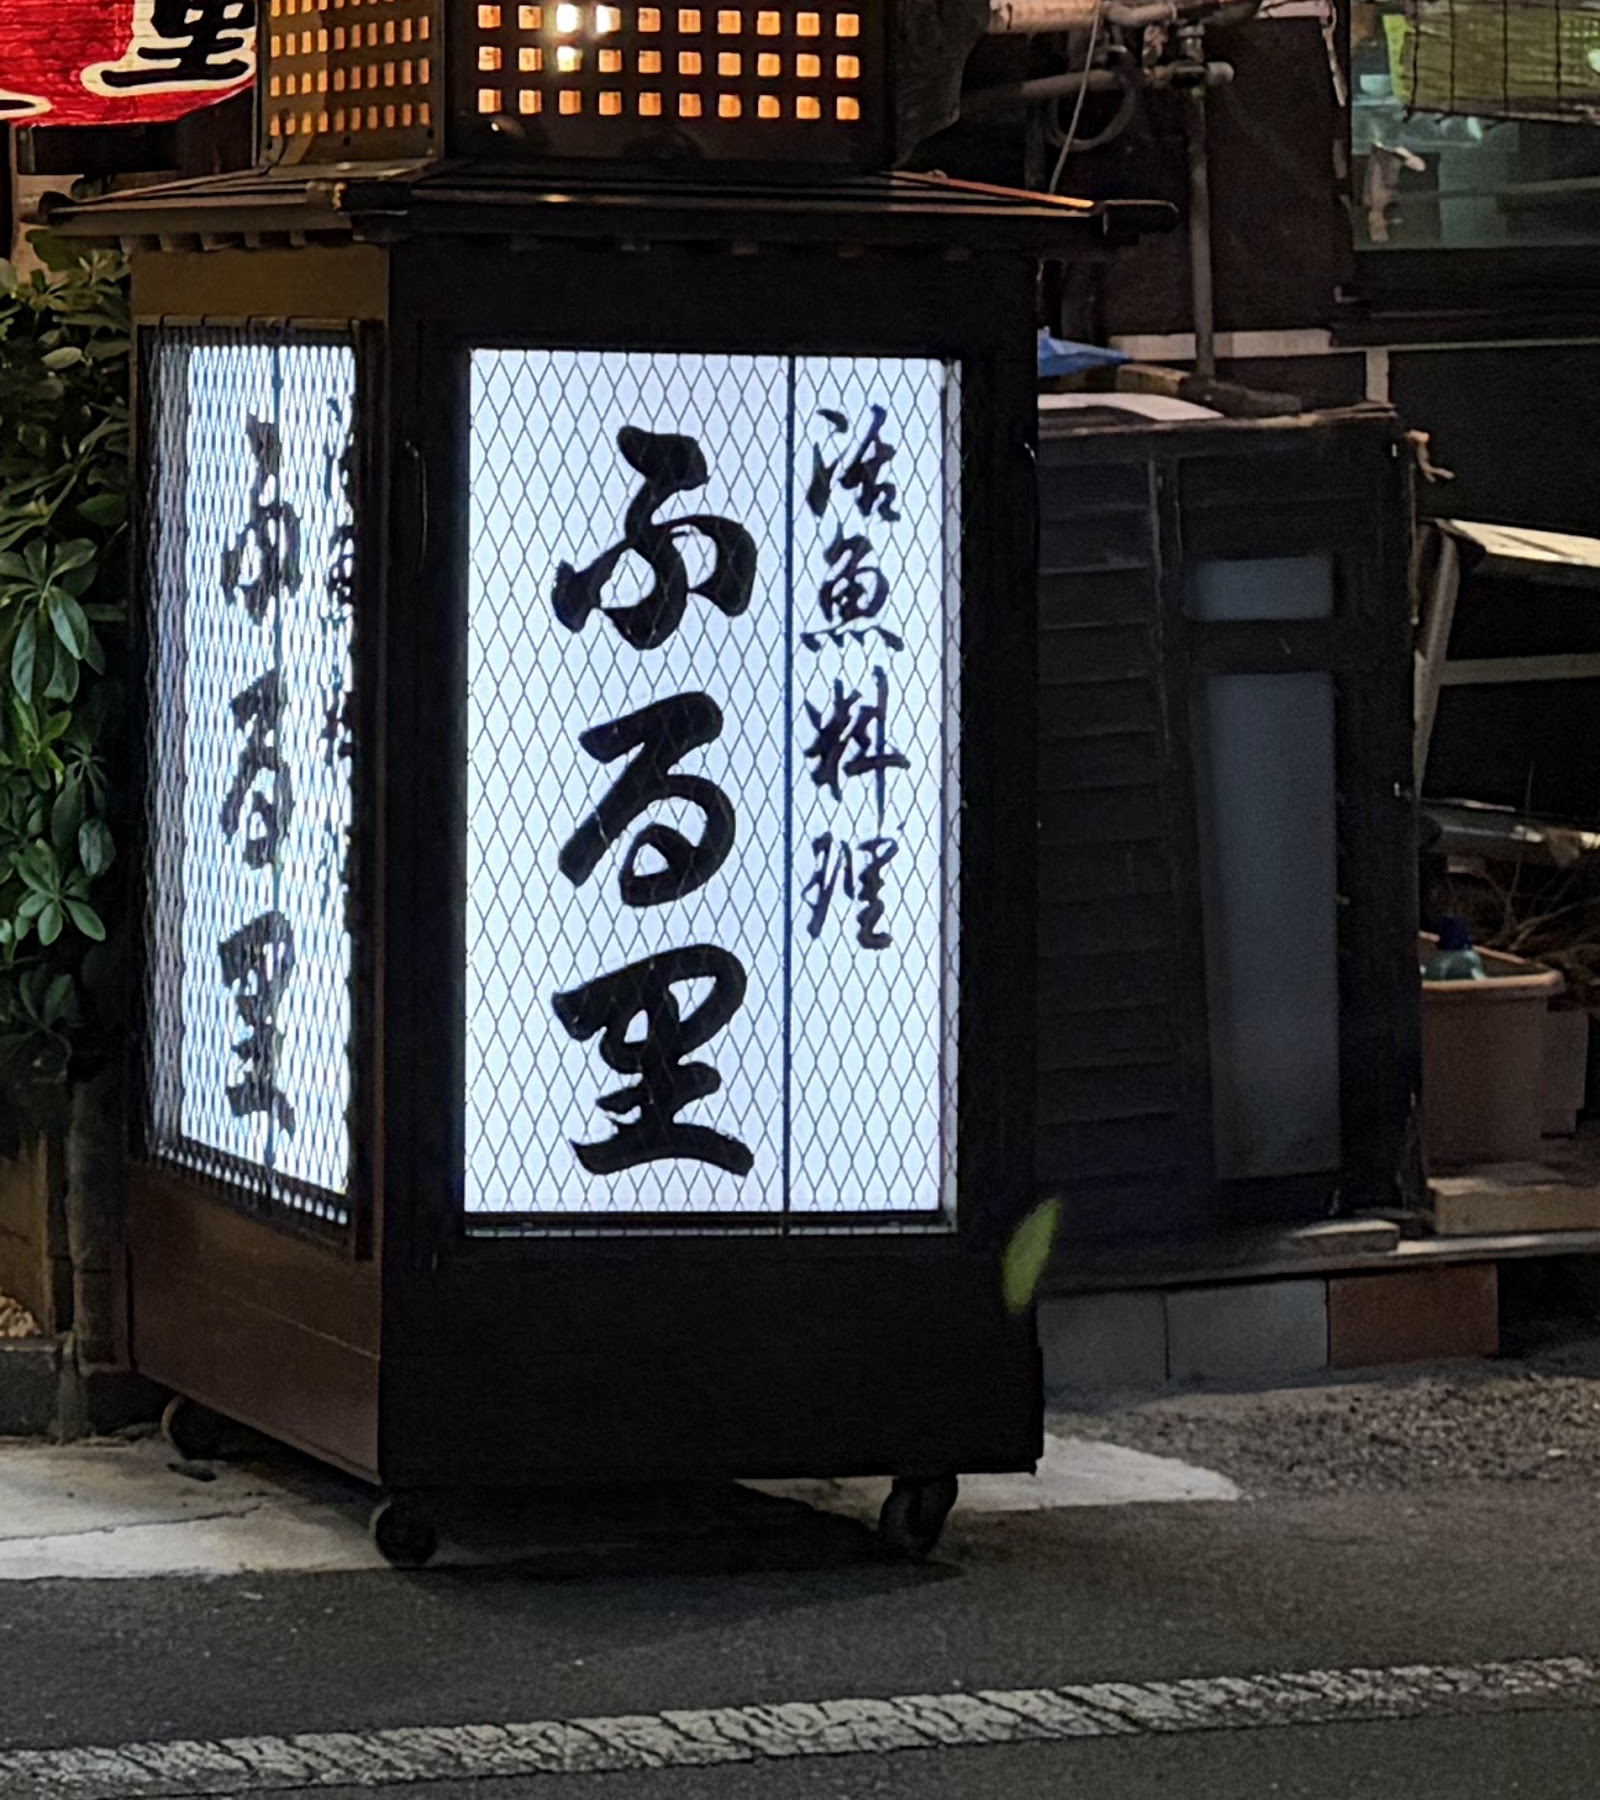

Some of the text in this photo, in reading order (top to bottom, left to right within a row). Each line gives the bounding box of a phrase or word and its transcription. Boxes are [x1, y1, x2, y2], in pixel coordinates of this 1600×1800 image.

[552, 426, 758, 1177] ふる里
[800, 407, 911, 950] 活魚料理
